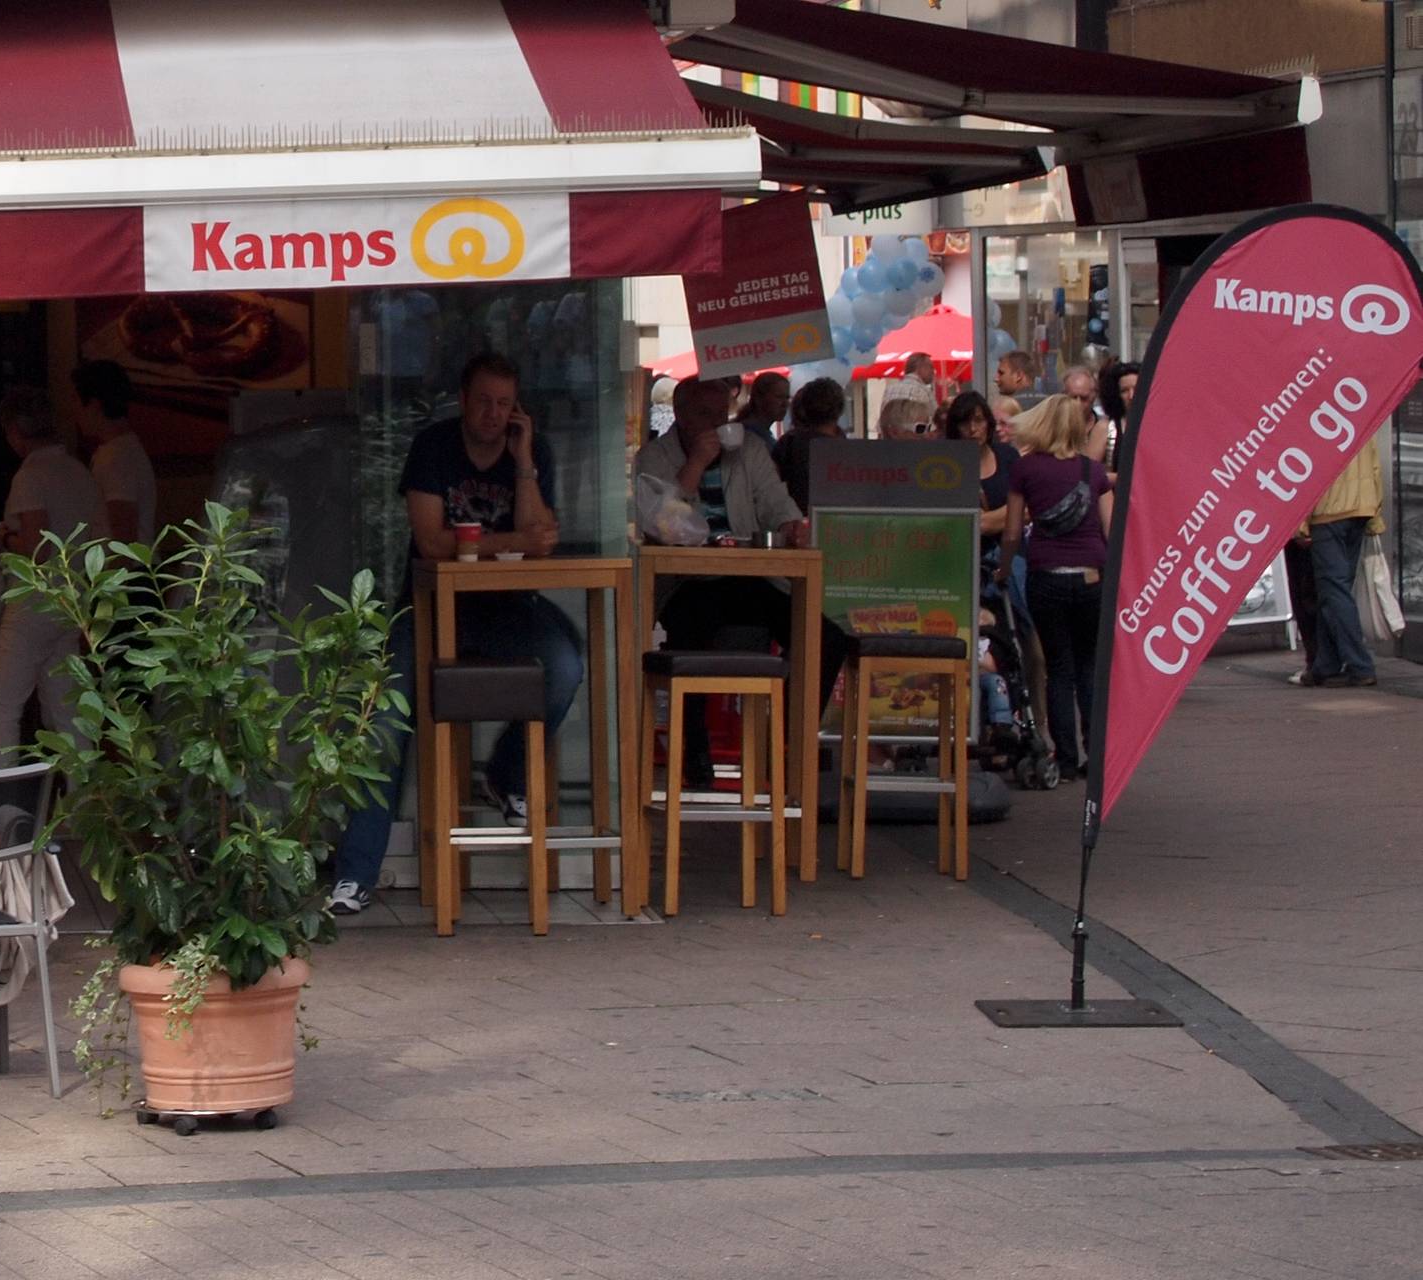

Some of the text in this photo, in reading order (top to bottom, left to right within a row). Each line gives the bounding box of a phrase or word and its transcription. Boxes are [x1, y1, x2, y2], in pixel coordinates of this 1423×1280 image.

[191, 221, 398, 282] Kamps
[697, 284, 813, 313] NEU GENIESSEN.
[734, 271, 809, 294] JEDEN TAG
[1214, 278, 1334, 326] Kamps
[704, 337, 776, 362] Kamps
[828, 464, 910, 487] Kamps
[1118, 347, 1334, 634] Genuss zum Mitnehmen:
[1143, 376, 1369, 676] Coffee to go
